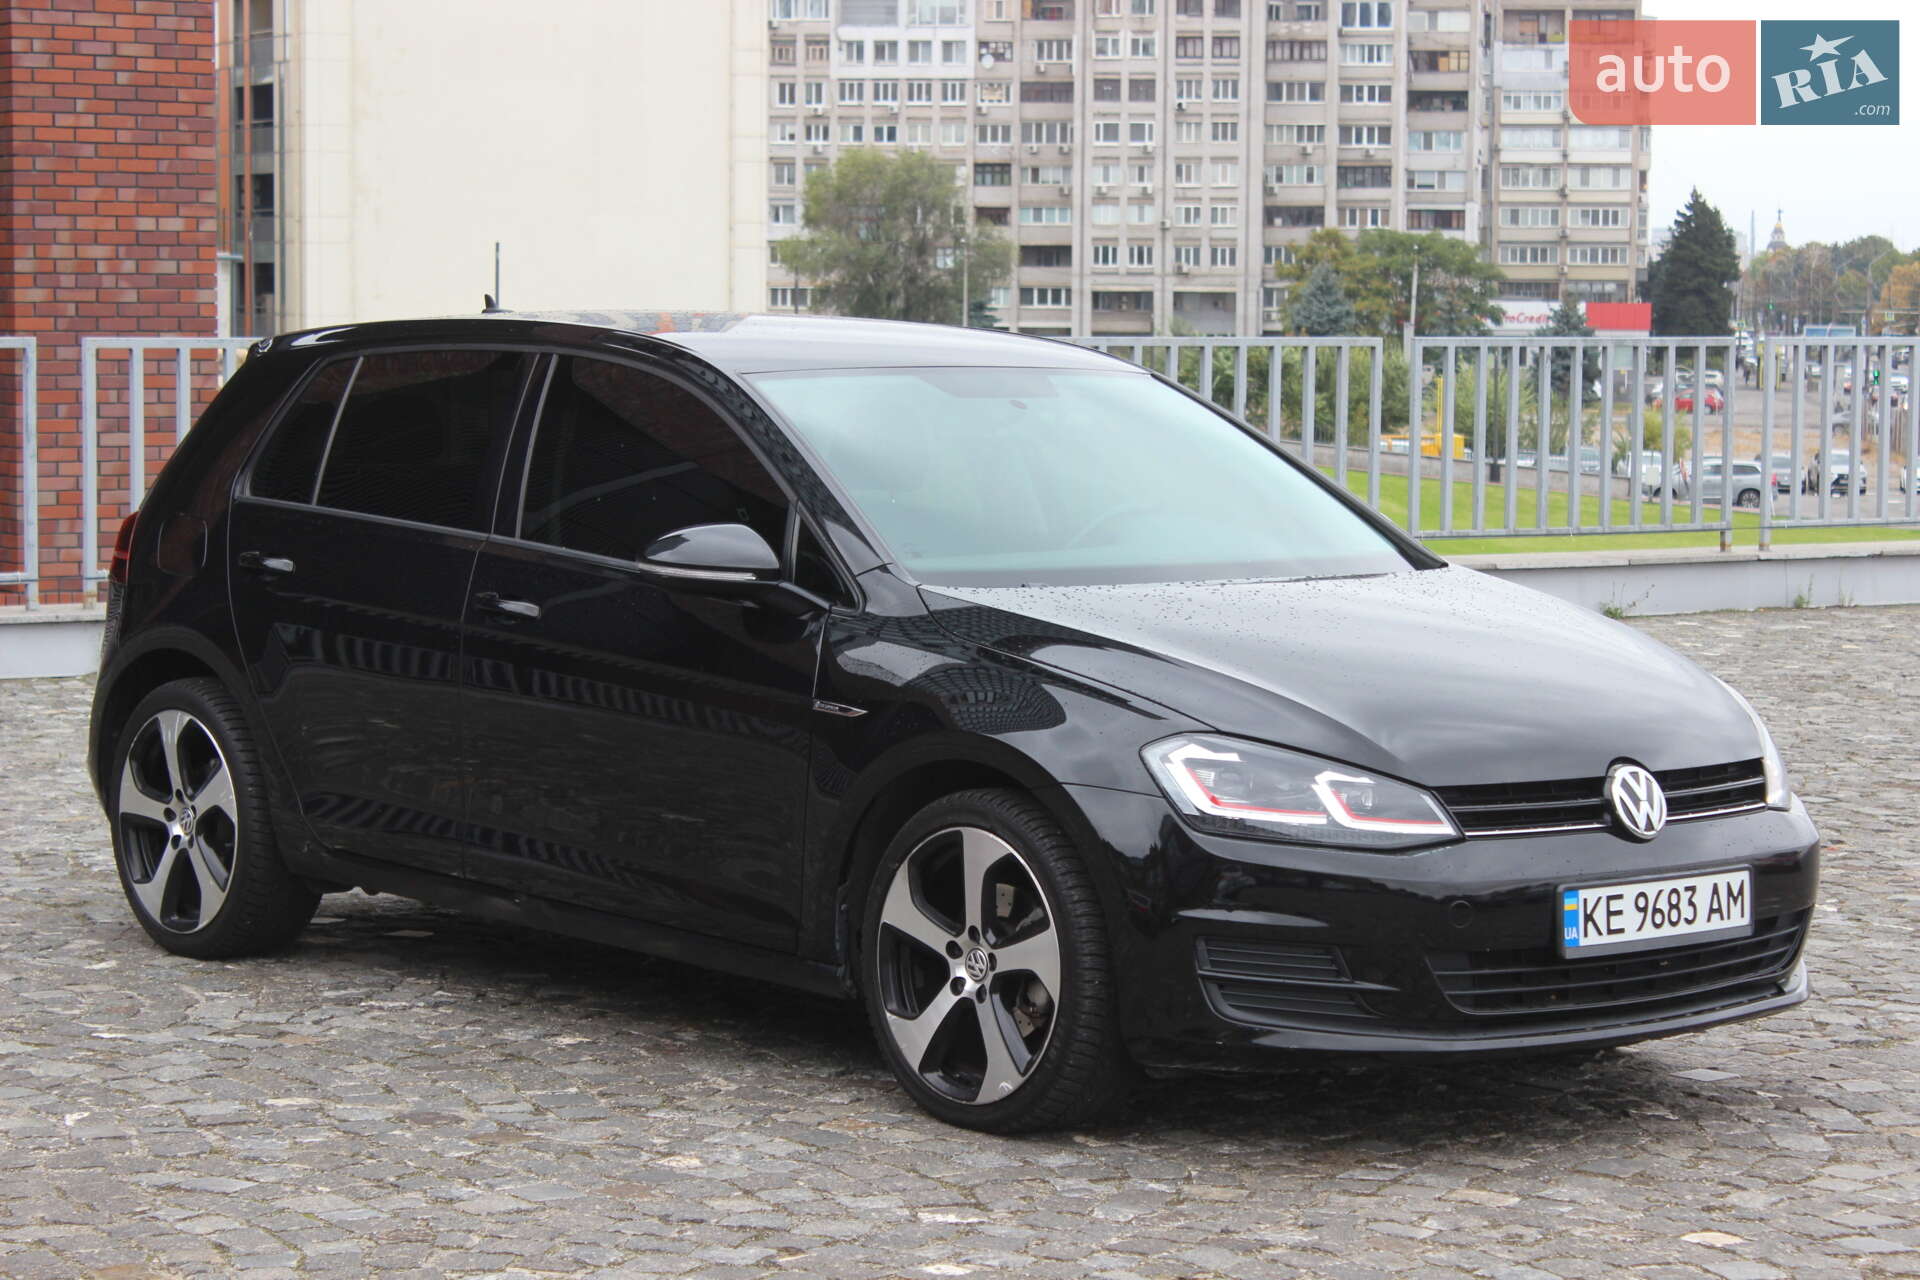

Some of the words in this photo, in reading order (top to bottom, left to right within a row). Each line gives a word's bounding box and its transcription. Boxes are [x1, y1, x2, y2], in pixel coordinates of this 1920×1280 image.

[1583, 894, 1625, 938] KE
[1634, 885, 1698, 932] 9683
[1706, 879, 1745, 923] AM
[1564, 926, 1579, 940] UA
